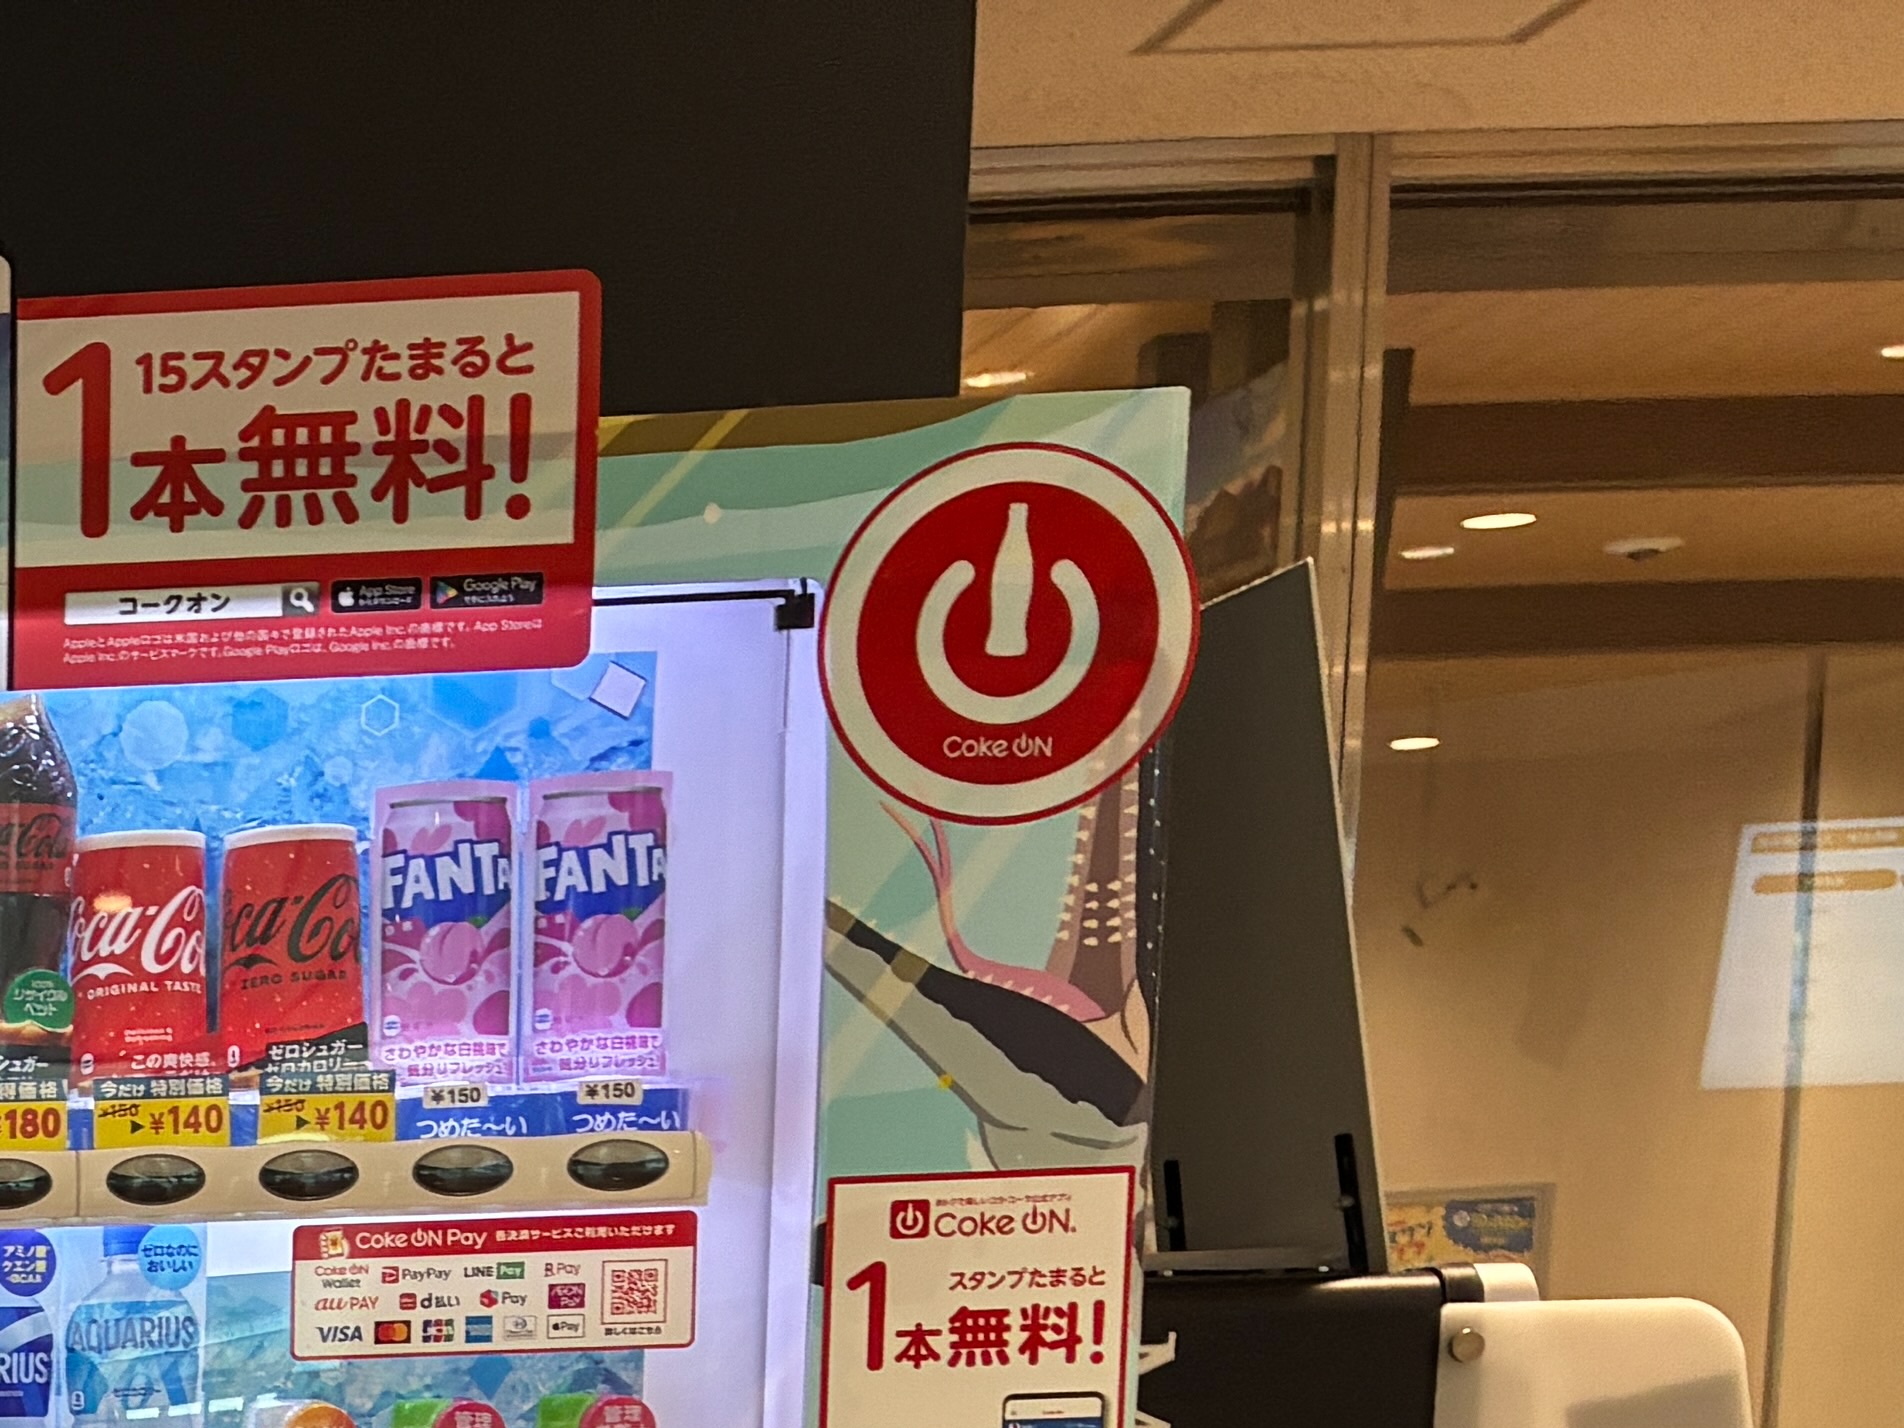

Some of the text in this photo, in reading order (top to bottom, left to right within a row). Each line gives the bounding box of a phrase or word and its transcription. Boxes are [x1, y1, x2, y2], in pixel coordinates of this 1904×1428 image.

[136, 332, 536, 396] 15スタンプたまると
[118, 591, 232, 616] コークオン
[943, 737, 1008, 758] Coke
[99, 1077, 222, 1095] 今だけ 特別価格
[431, 1086, 481, 1104] ¥150
[149, 1104, 223, 1135] ¥140
[934, 1211, 1015, 1238] Coke
[355, 1229, 408, 1249] Coke
[447, 1228, 487, 1250] Pay
[950, 1266, 1106, 1290] スタンプたまると
[71, 1316, 195, 1350] AQUARIUS
[318, 1325, 363, 1342] VISA
